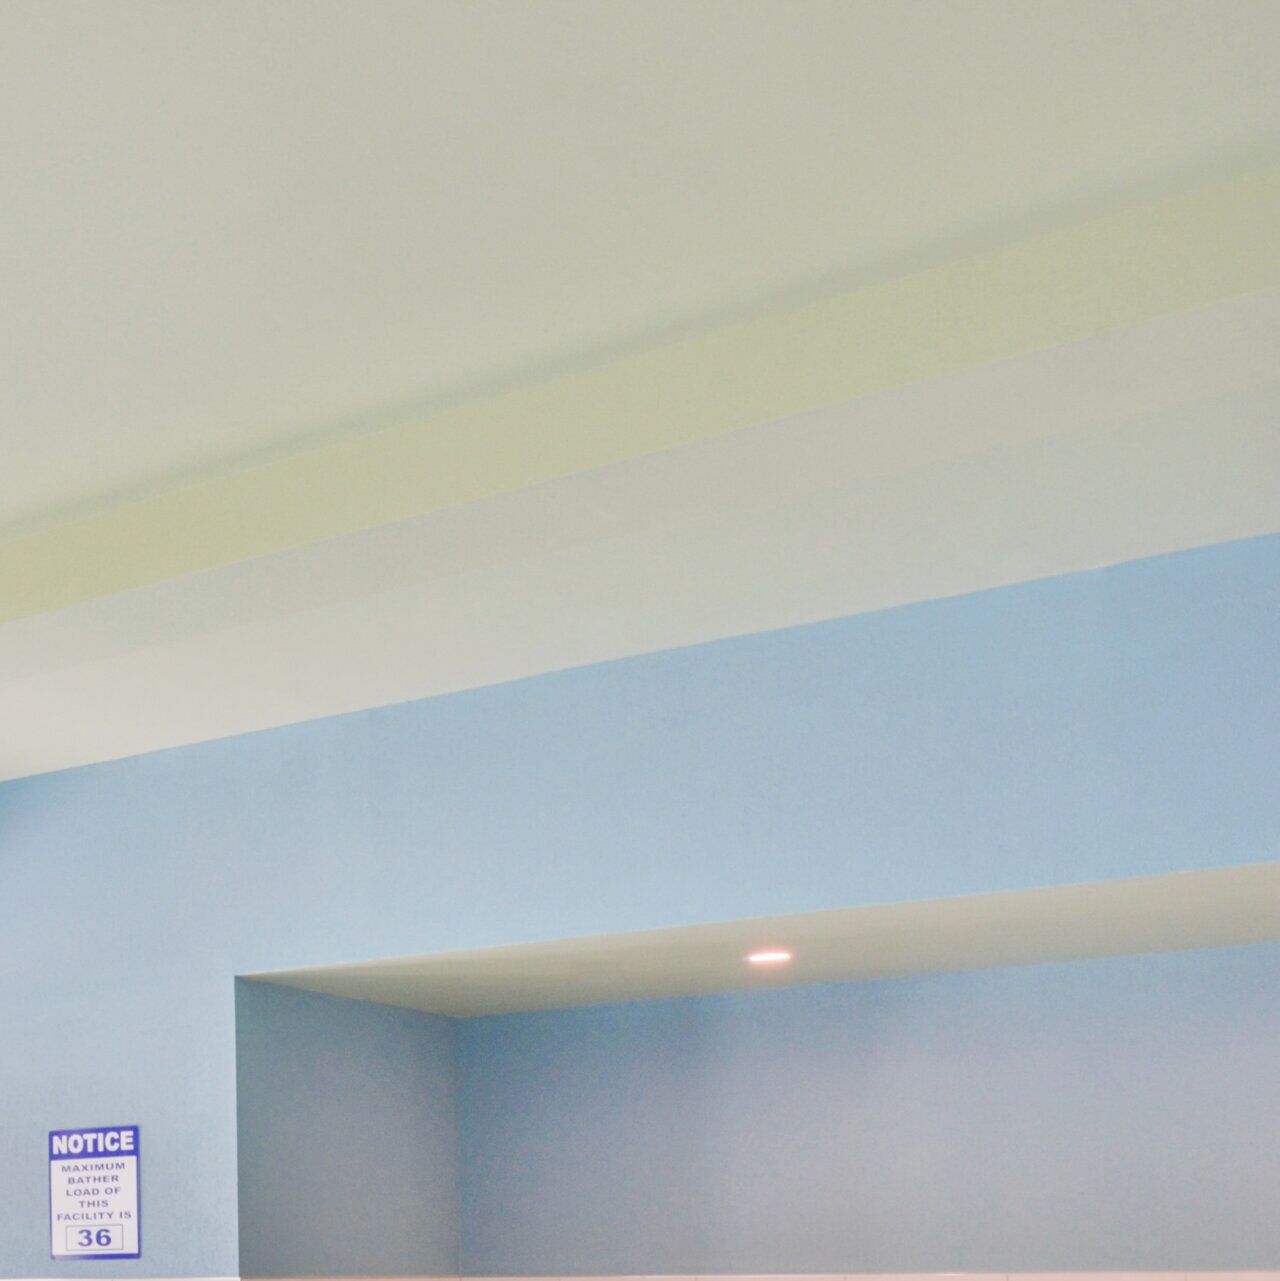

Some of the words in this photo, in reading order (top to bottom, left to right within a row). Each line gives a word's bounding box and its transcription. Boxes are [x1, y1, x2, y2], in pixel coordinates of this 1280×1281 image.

[52, 1130, 135, 1155] NOTICE
[61, 1162, 126, 1173] MAXIMUM
[67, 1174, 120, 1185] BATHER
[66, 1187, 100, 1197] LOAD
[104, 1186, 121, 1195] OF
[79, 1200, 109, 1208] THIS
[57, 1211, 114, 1221] FACILITY
[120, 1211, 132, 1219] IS
[78, 1229, 112, 1247] 36
